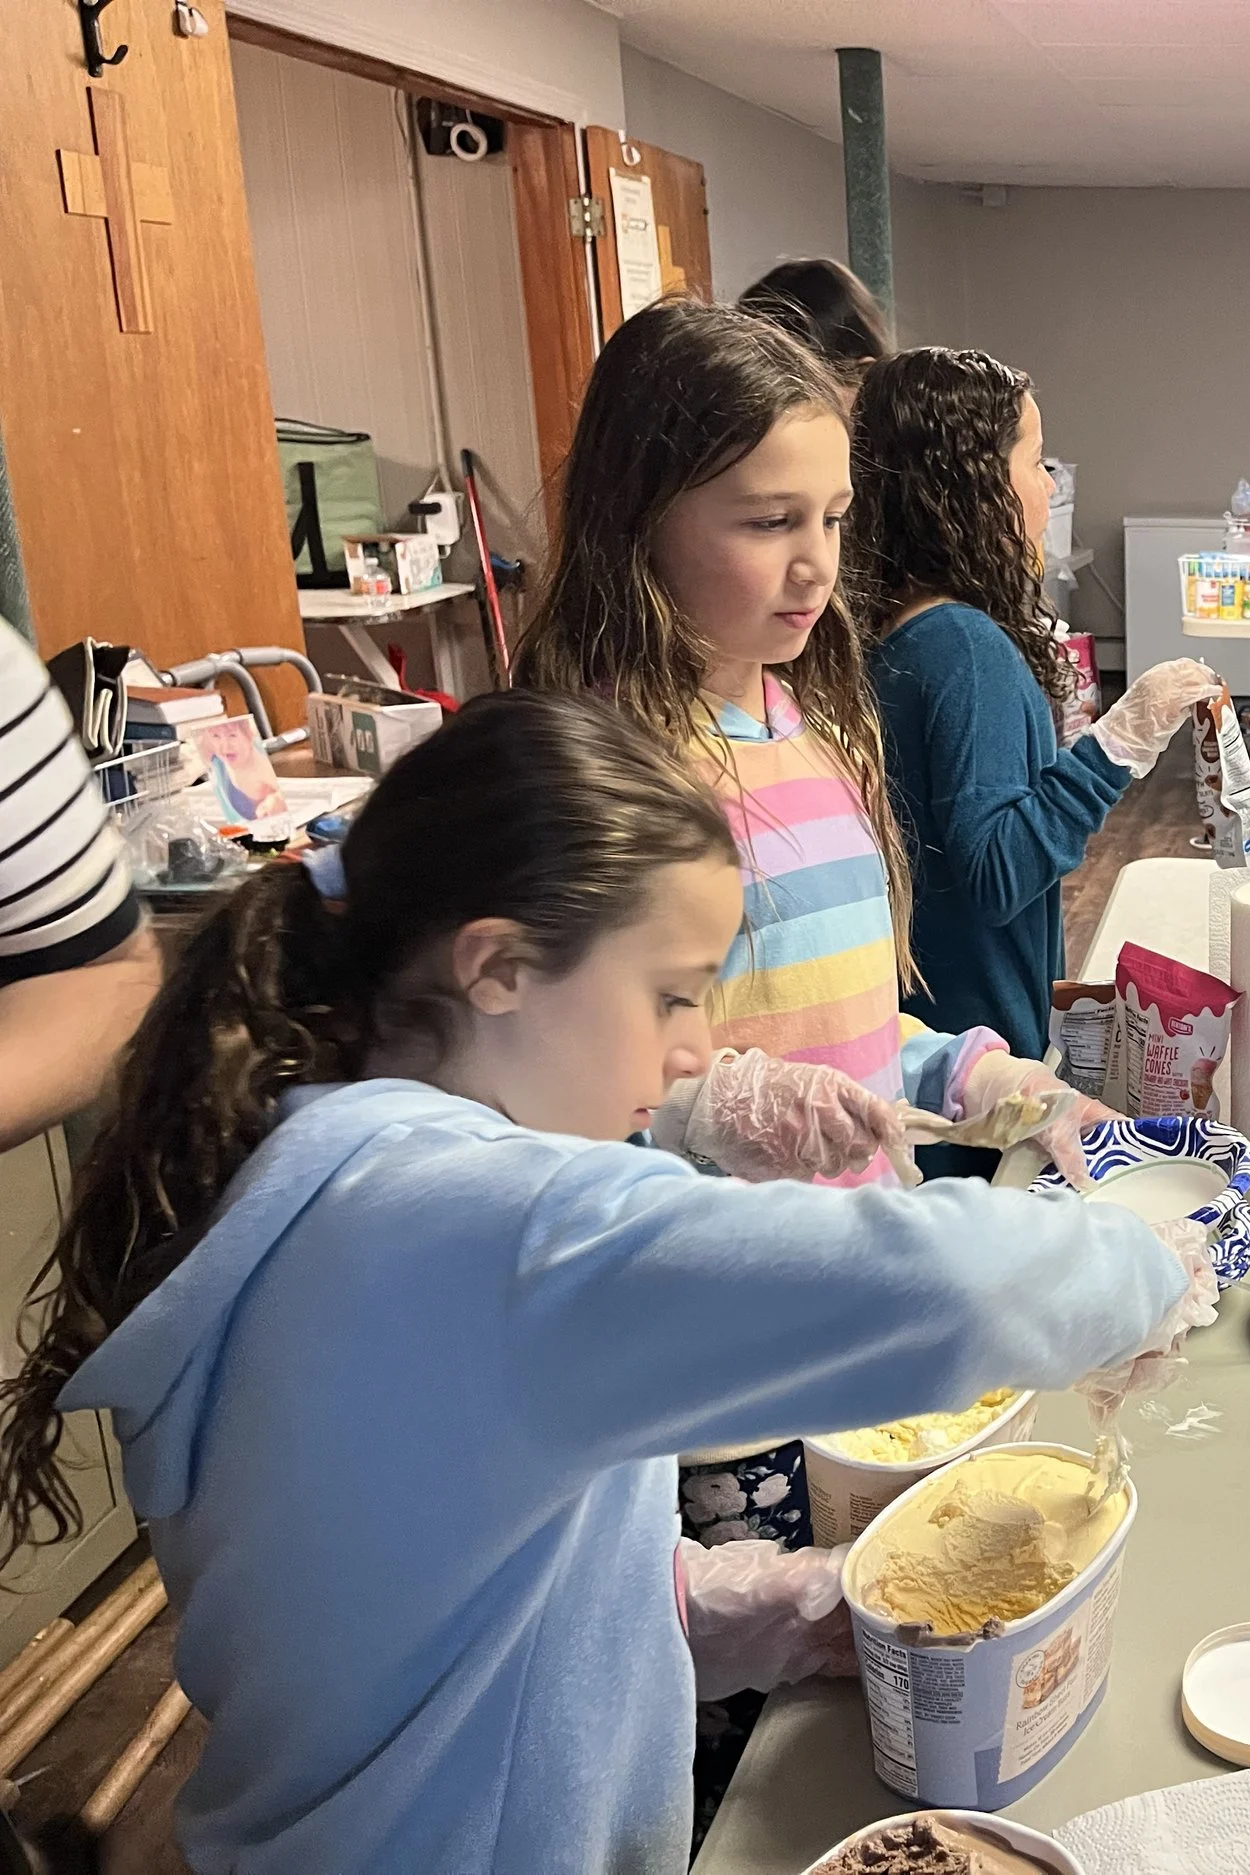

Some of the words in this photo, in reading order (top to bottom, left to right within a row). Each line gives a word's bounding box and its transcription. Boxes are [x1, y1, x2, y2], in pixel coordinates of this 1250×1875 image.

[1147, 1043, 1179, 1060] WAFFLE
[1145, 1058, 1171, 1075] CONES
[887, 1645, 907, 1659] Facts
[893, 1675, 909, 1690] 170
[1016, 1704, 1049, 1731] Rainbow
[1023, 1725, 1035, 1737] Ice
